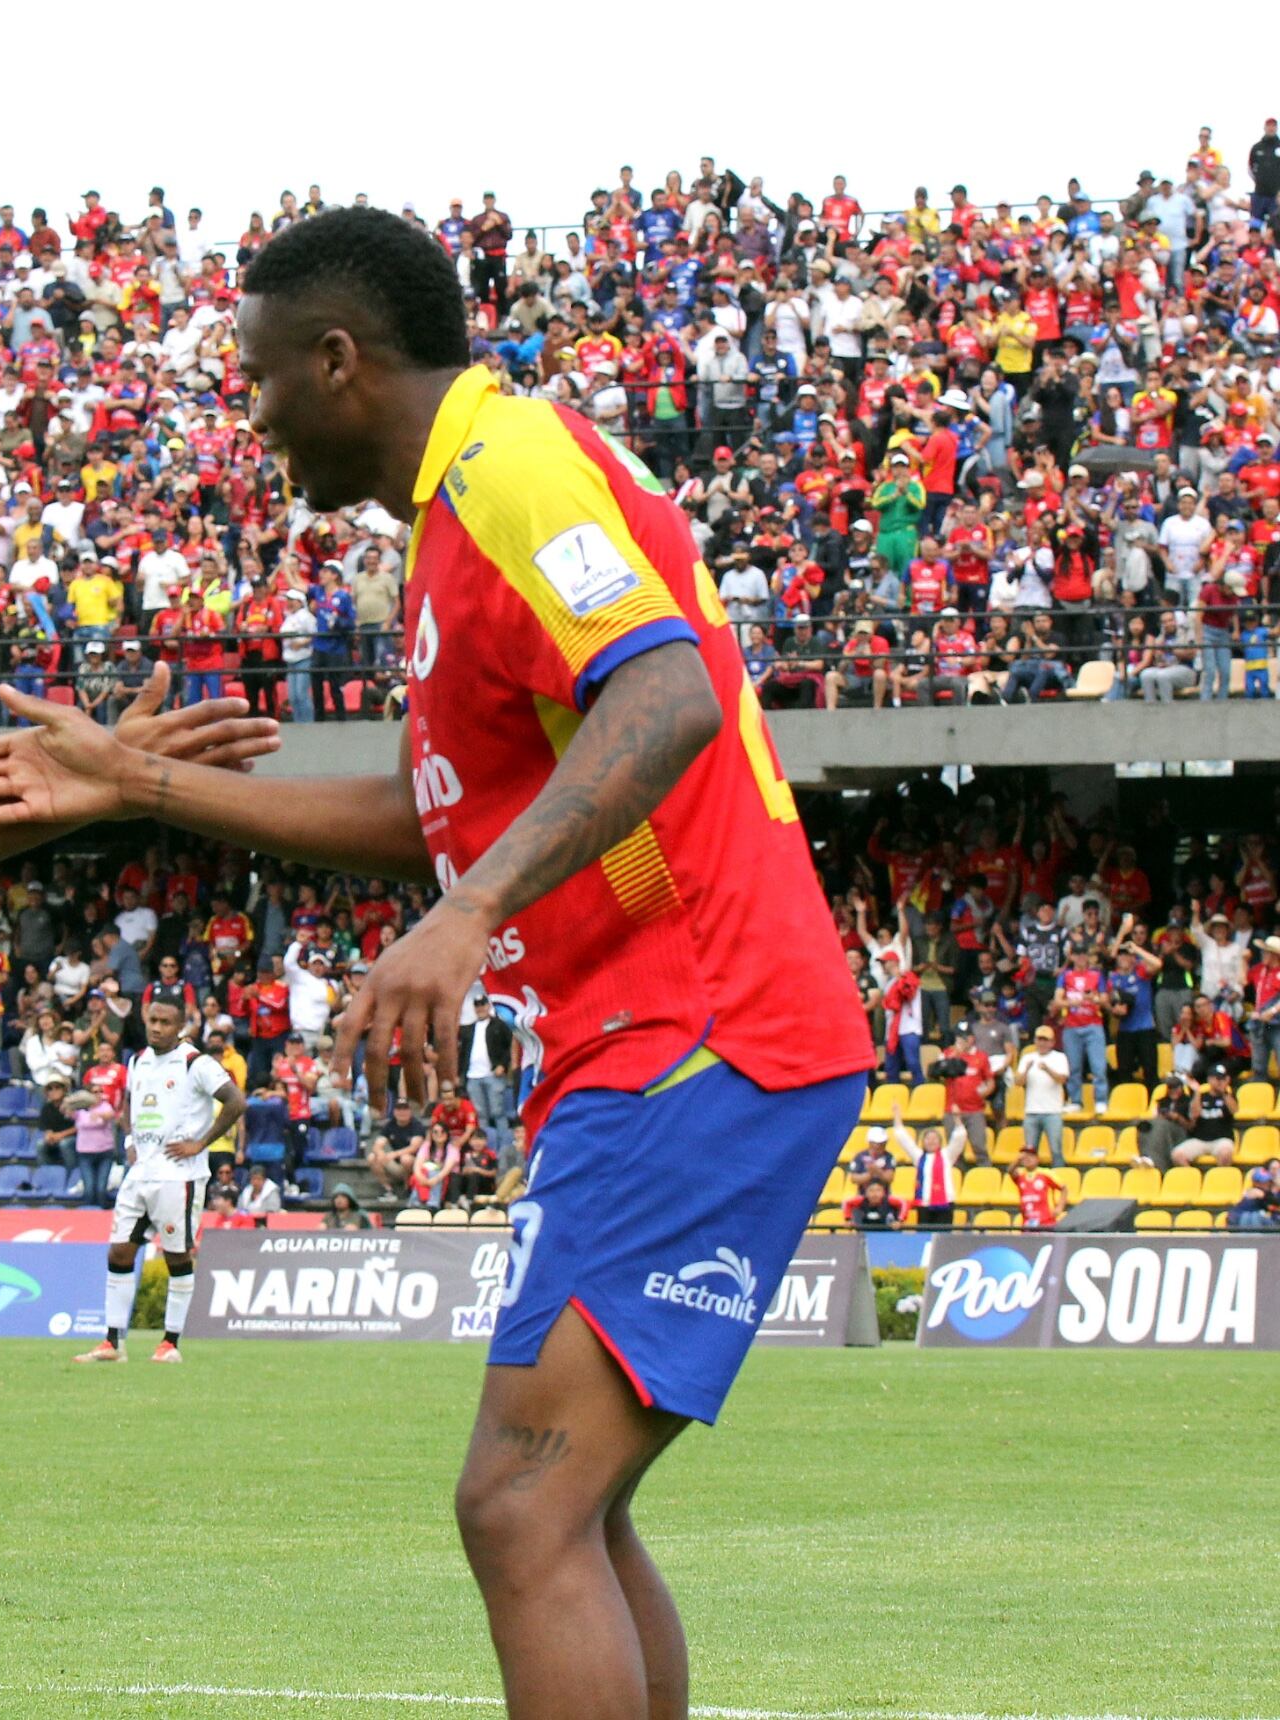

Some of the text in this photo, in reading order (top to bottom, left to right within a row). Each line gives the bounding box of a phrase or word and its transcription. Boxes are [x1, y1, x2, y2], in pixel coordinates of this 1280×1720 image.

[259, 1238, 402, 1253] AGUARDIENTE
[208, 1256, 440, 1319] NARIÑO
[643, 1271, 757, 1324] Electrolit
[926, 1244, 1053, 1329] Pool
[1057, 1247, 1258, 1344] SODA
[227, 1319, 402, 1332] LA ESENCIA DE NUESTRA TIERRA
